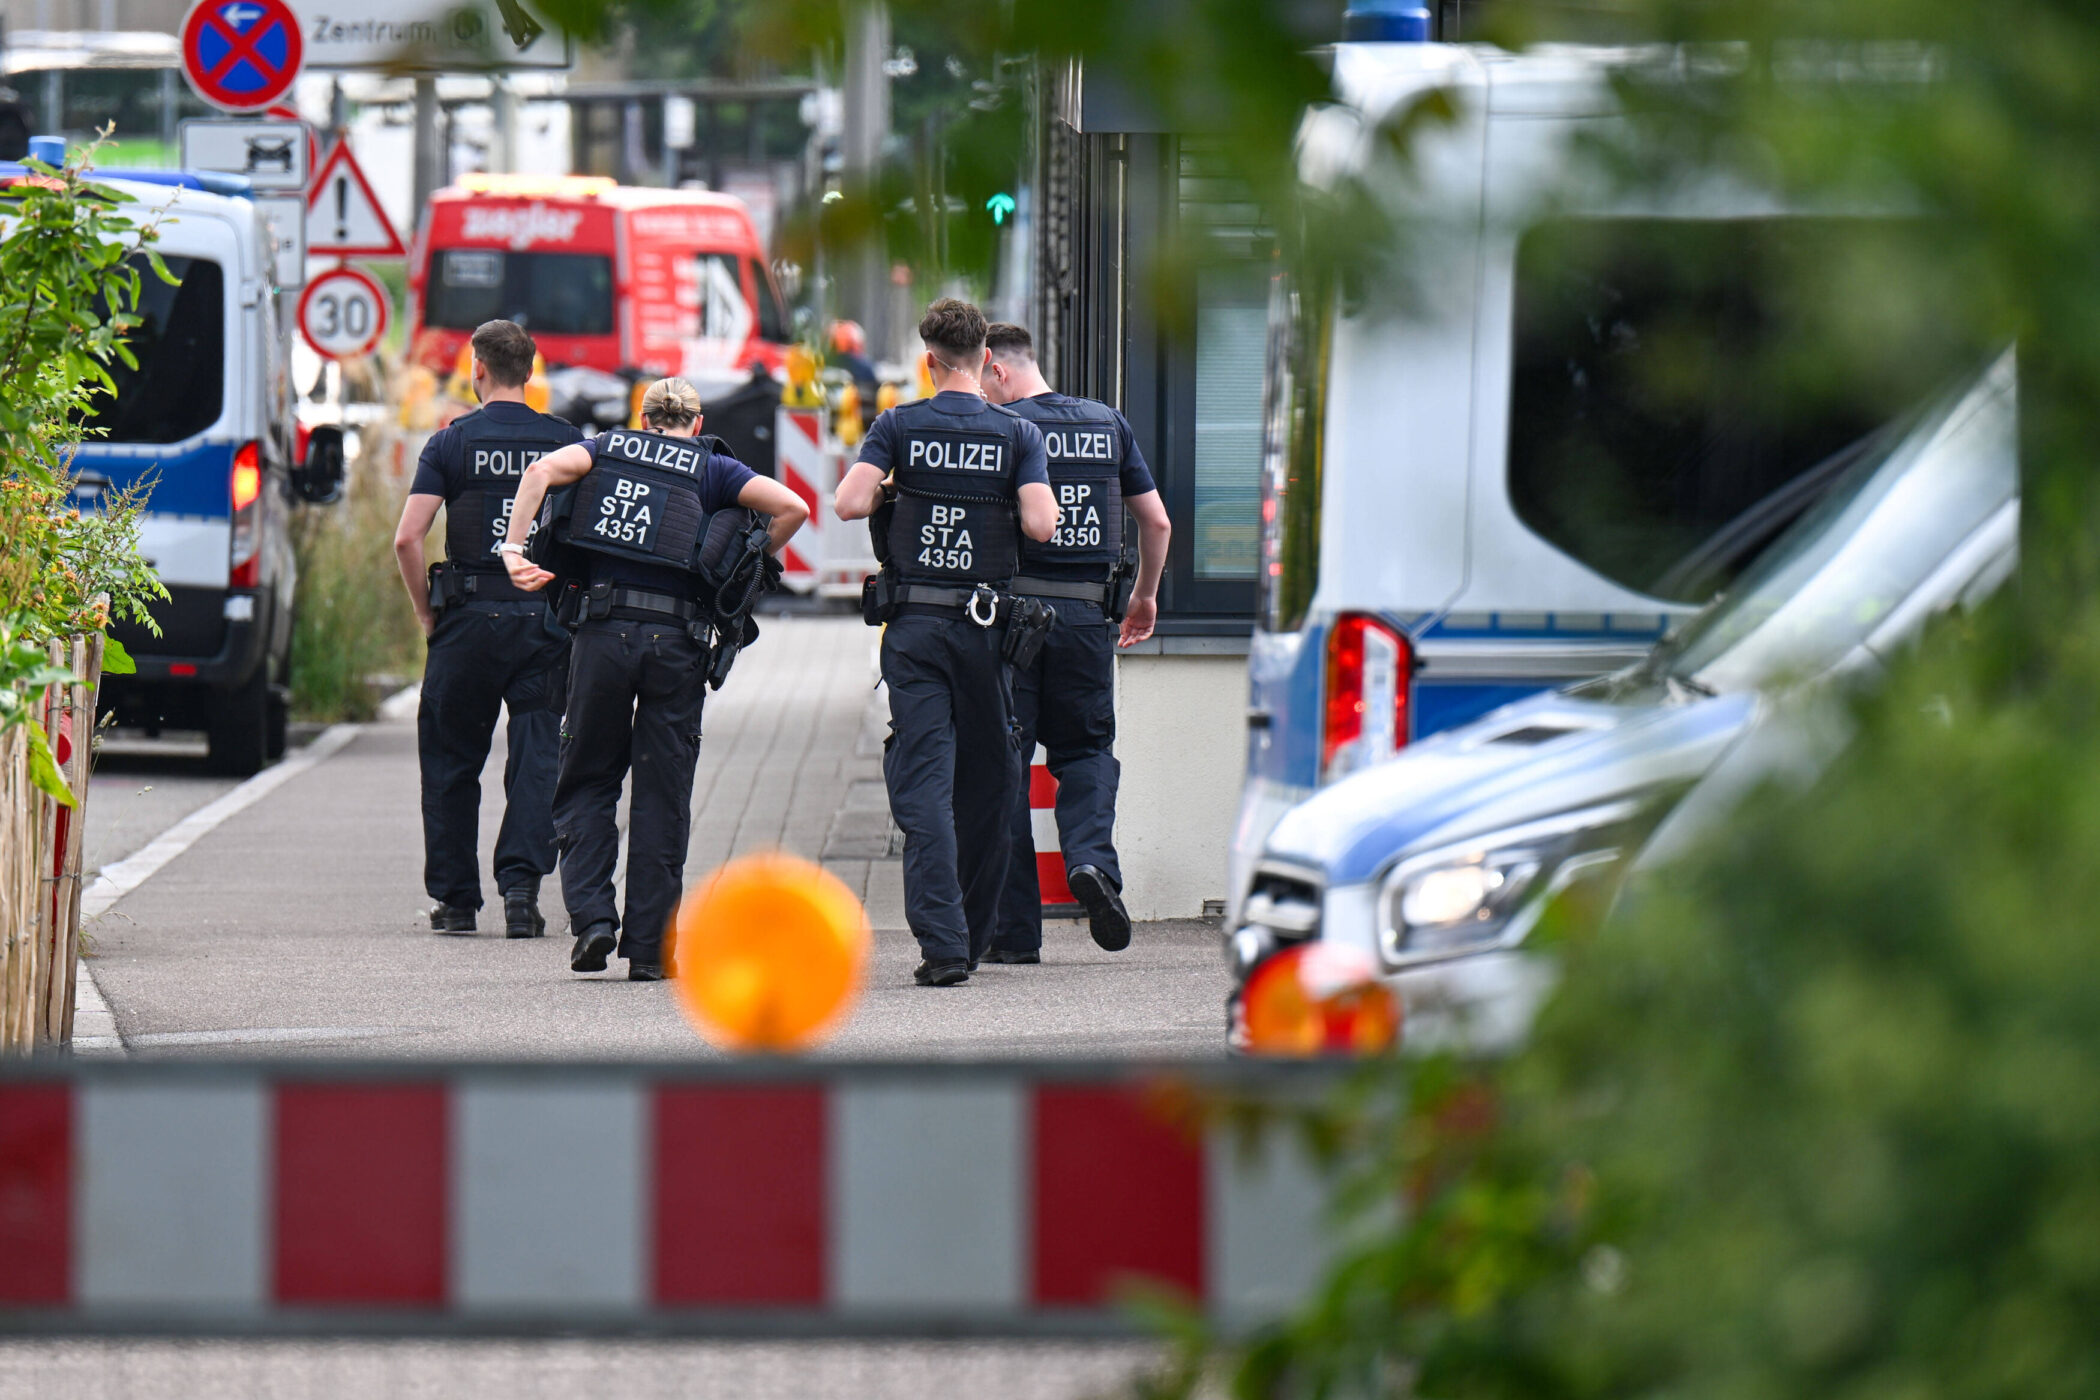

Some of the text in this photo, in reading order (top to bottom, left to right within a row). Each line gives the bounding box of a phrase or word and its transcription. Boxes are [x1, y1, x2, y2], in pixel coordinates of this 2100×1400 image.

[317, 293, 369, 338] 30
[607, 433, 700, 474] POLIZEI
[909, 440, 1003, 472] POLIZEI
[1045, 432, 1112, 459] OLIZEI
[614, 478, 650, 499] BP
[1060, 484, 1091, 505] BP
[600, 495, 652, 525] STA
[931, 504, 966, 526] BP
[1055, 505, 1101, 526] STA
[594, 517, 647, 545] 4351
[920, 525, 973, 549] STA
[1050, 526, 1101, 547] 4350
[918, 548, 973, 571] 4350
